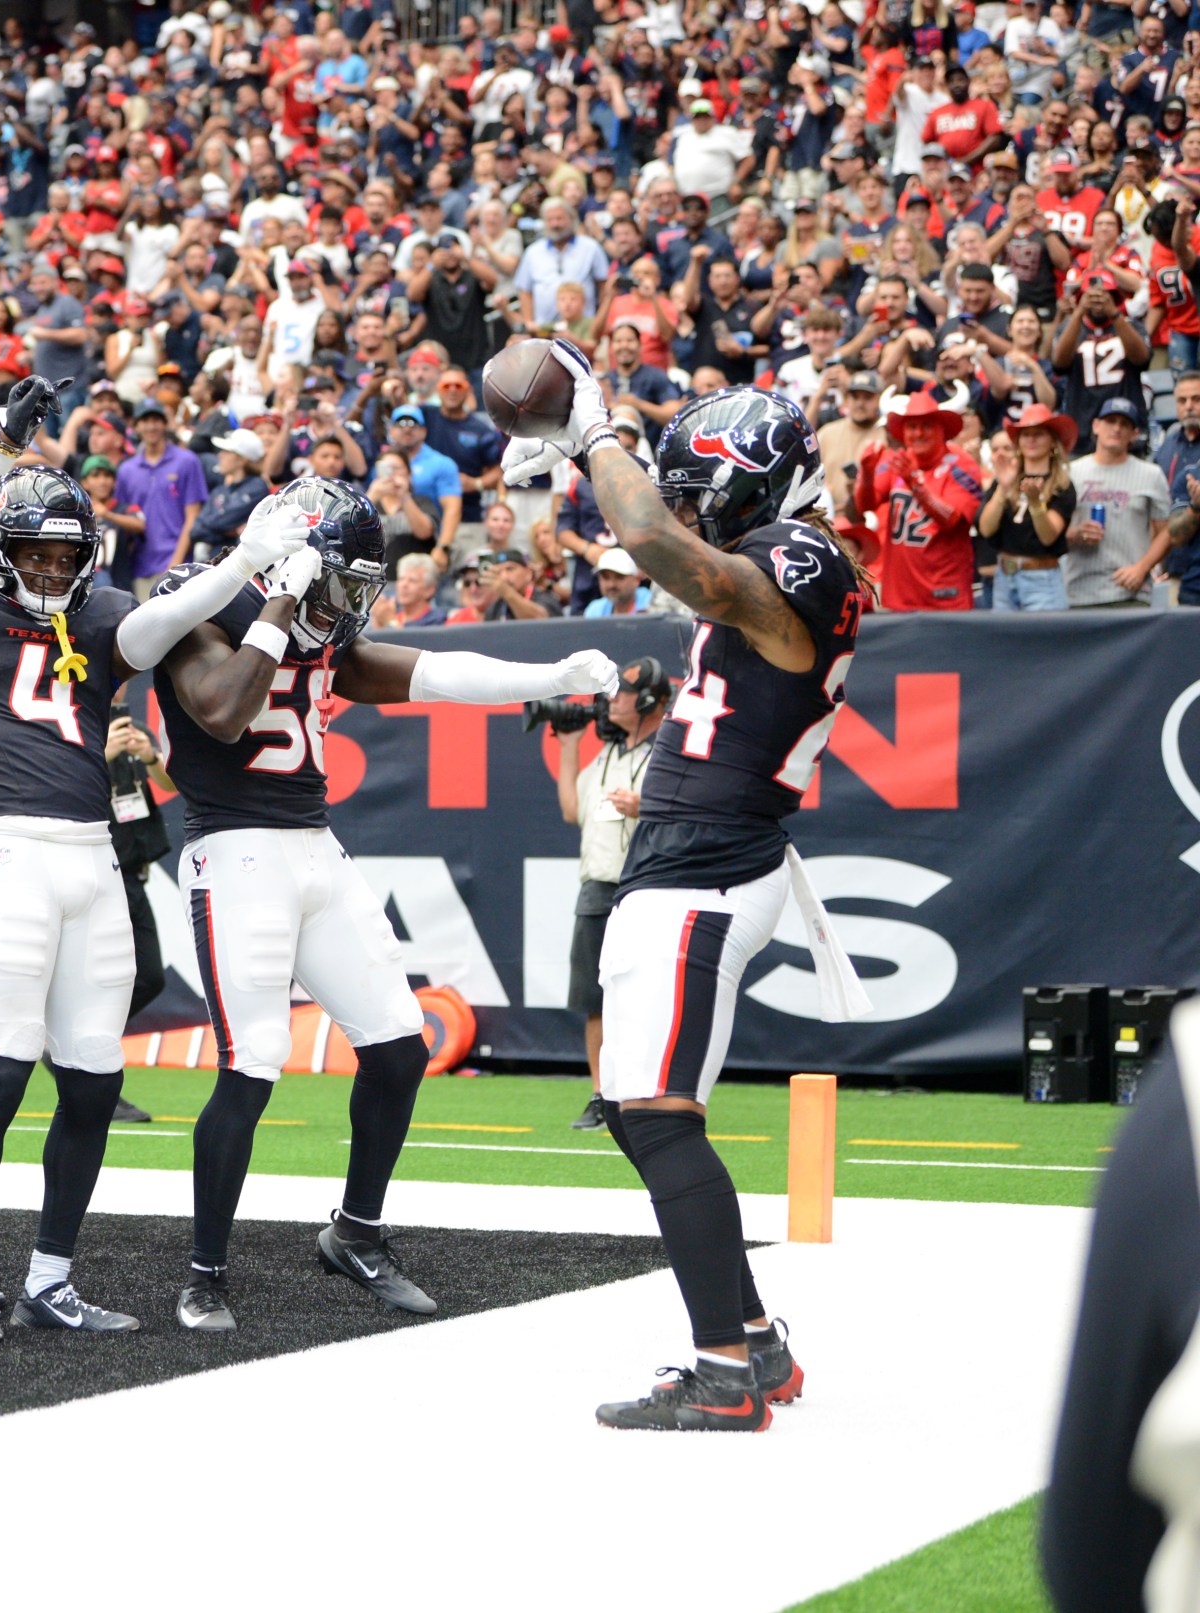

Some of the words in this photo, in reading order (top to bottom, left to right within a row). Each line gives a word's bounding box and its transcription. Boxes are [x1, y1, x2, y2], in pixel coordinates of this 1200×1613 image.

[1149, 67, 1168, 102] 7
[1105, 100, 1124, 129] 7
[284, 323, 302, 353] 5
[1077, 336, 1126, 388] 12
[890, 489, 933, 547] 02
[9, 641, 85, 746] 4
[665, 618, 736, 760] 4
